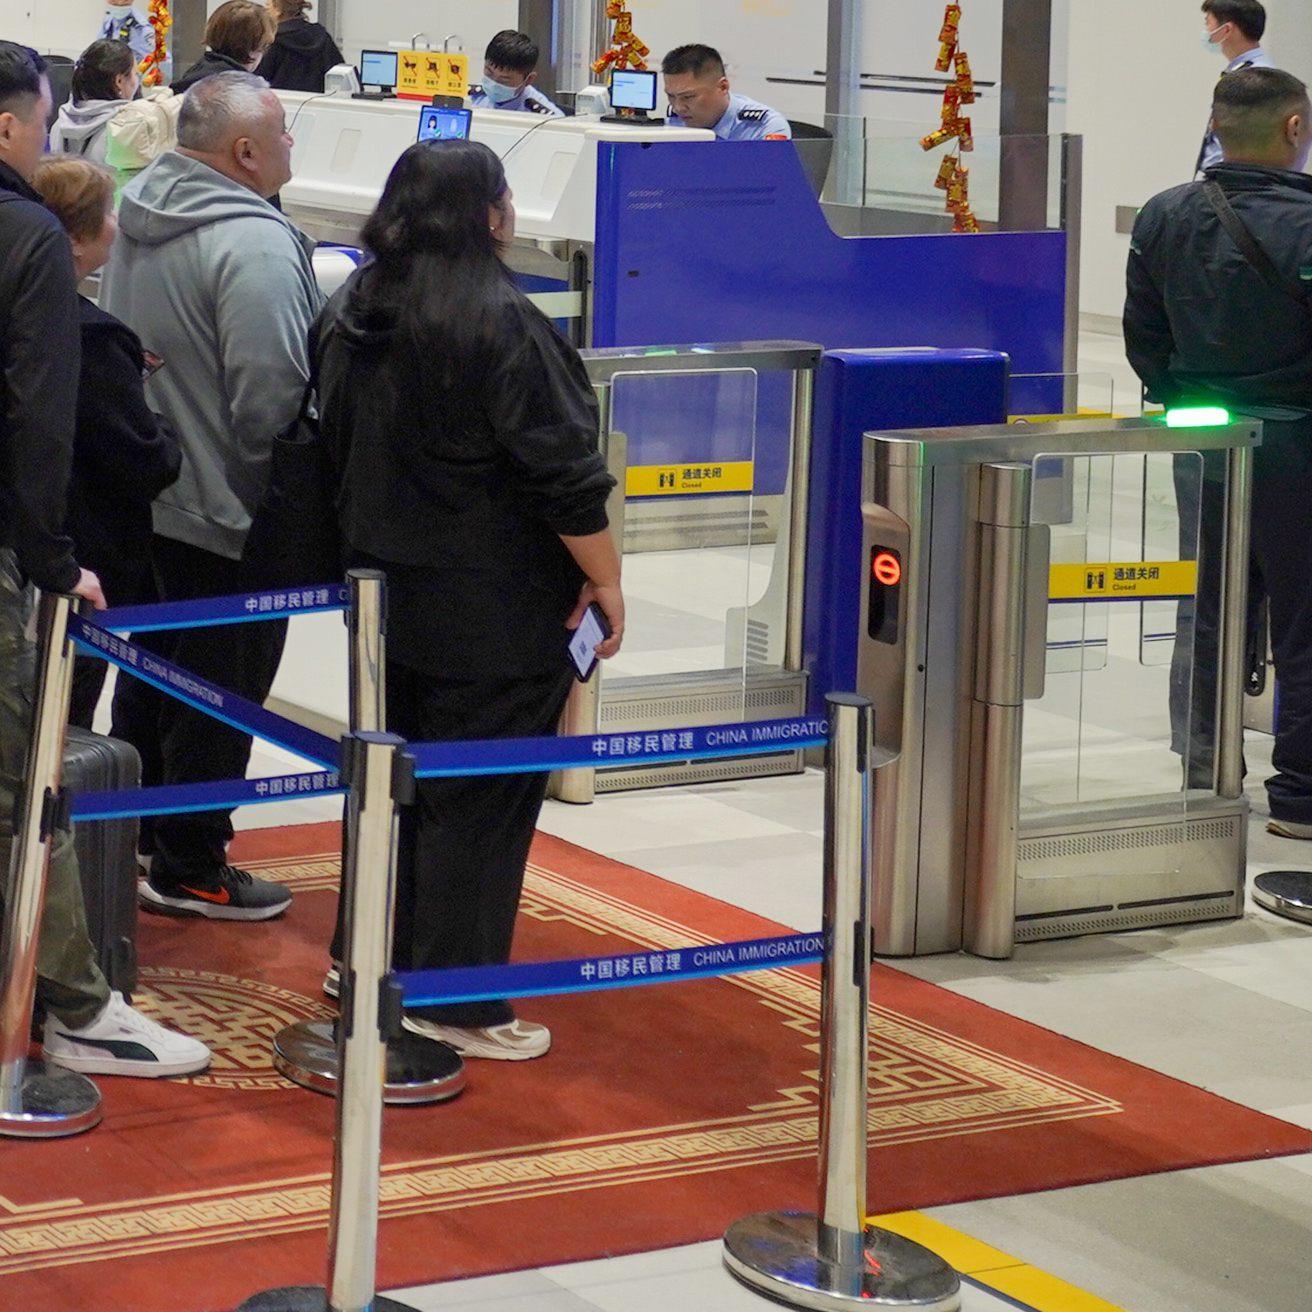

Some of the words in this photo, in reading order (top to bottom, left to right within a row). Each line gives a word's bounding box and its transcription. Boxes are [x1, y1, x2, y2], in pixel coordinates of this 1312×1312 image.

[682, 467, 722, 480] 通道关闭
[1114, 567, 1159, 581] 通道关闭
[245, 589, 329, 612] 中国移民管理
[592, 731, 693, 757] 中国移民管理
[705, 730, 749, 747] CHINA
[752, 720, 829, 741] IMMIGRATIO
[255, 773, 339, 796] 中国移民管理
[693, 949, 736, 967] CHINA
[738, 938, 825, 961] IMMIGRATION
[580, 954, 682, 981] 中国移民管理
